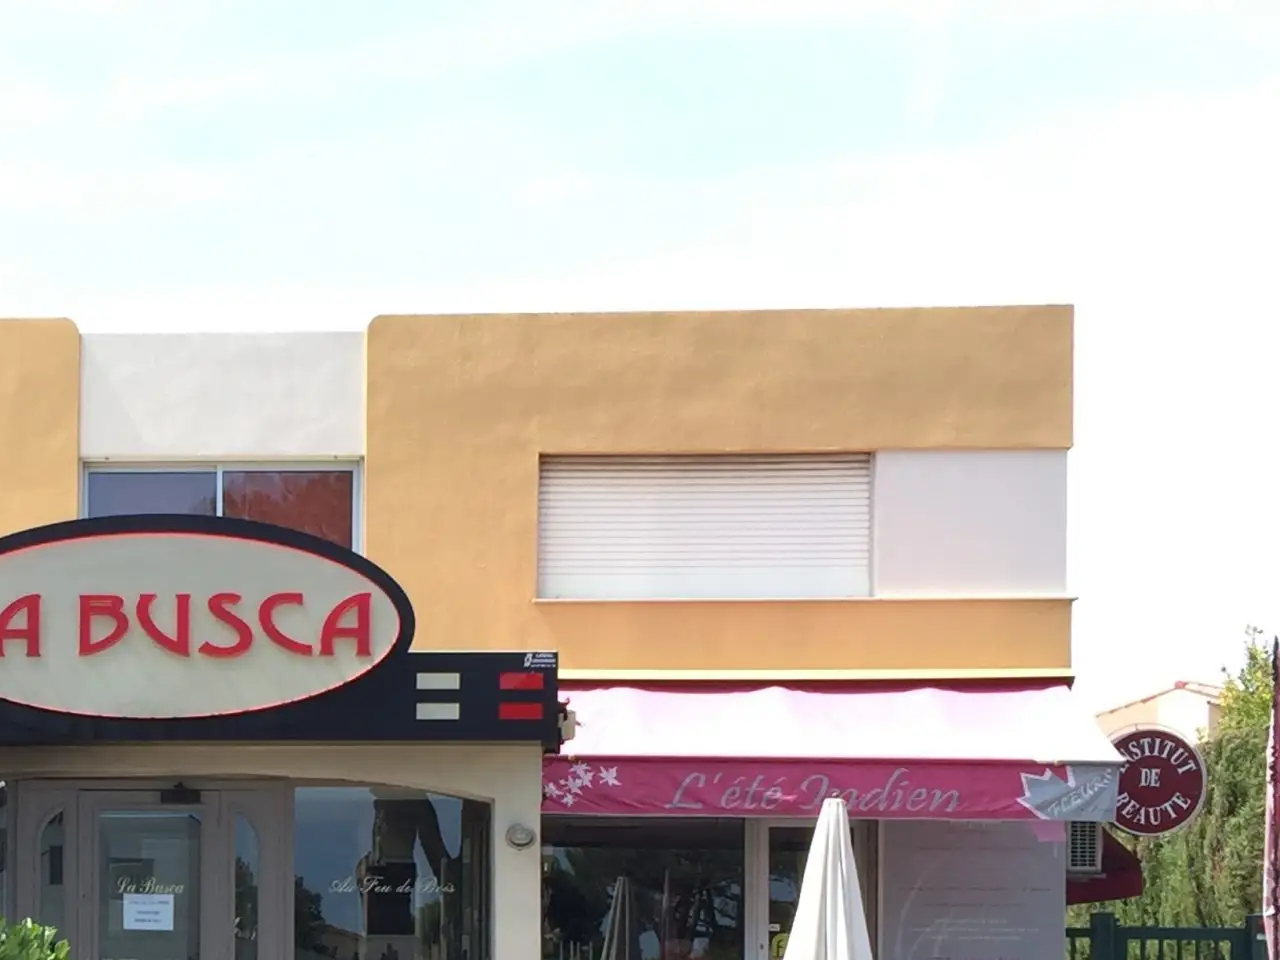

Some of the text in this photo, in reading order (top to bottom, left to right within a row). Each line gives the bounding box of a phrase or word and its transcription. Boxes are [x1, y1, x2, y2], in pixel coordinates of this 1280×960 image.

[78, 591, 373, 658] BUSCA
[1119, 737, 1198, 775] NSTITUT
[1139, 768, 1161, 788] DE
[116, 876, 185, 895] La Busca
